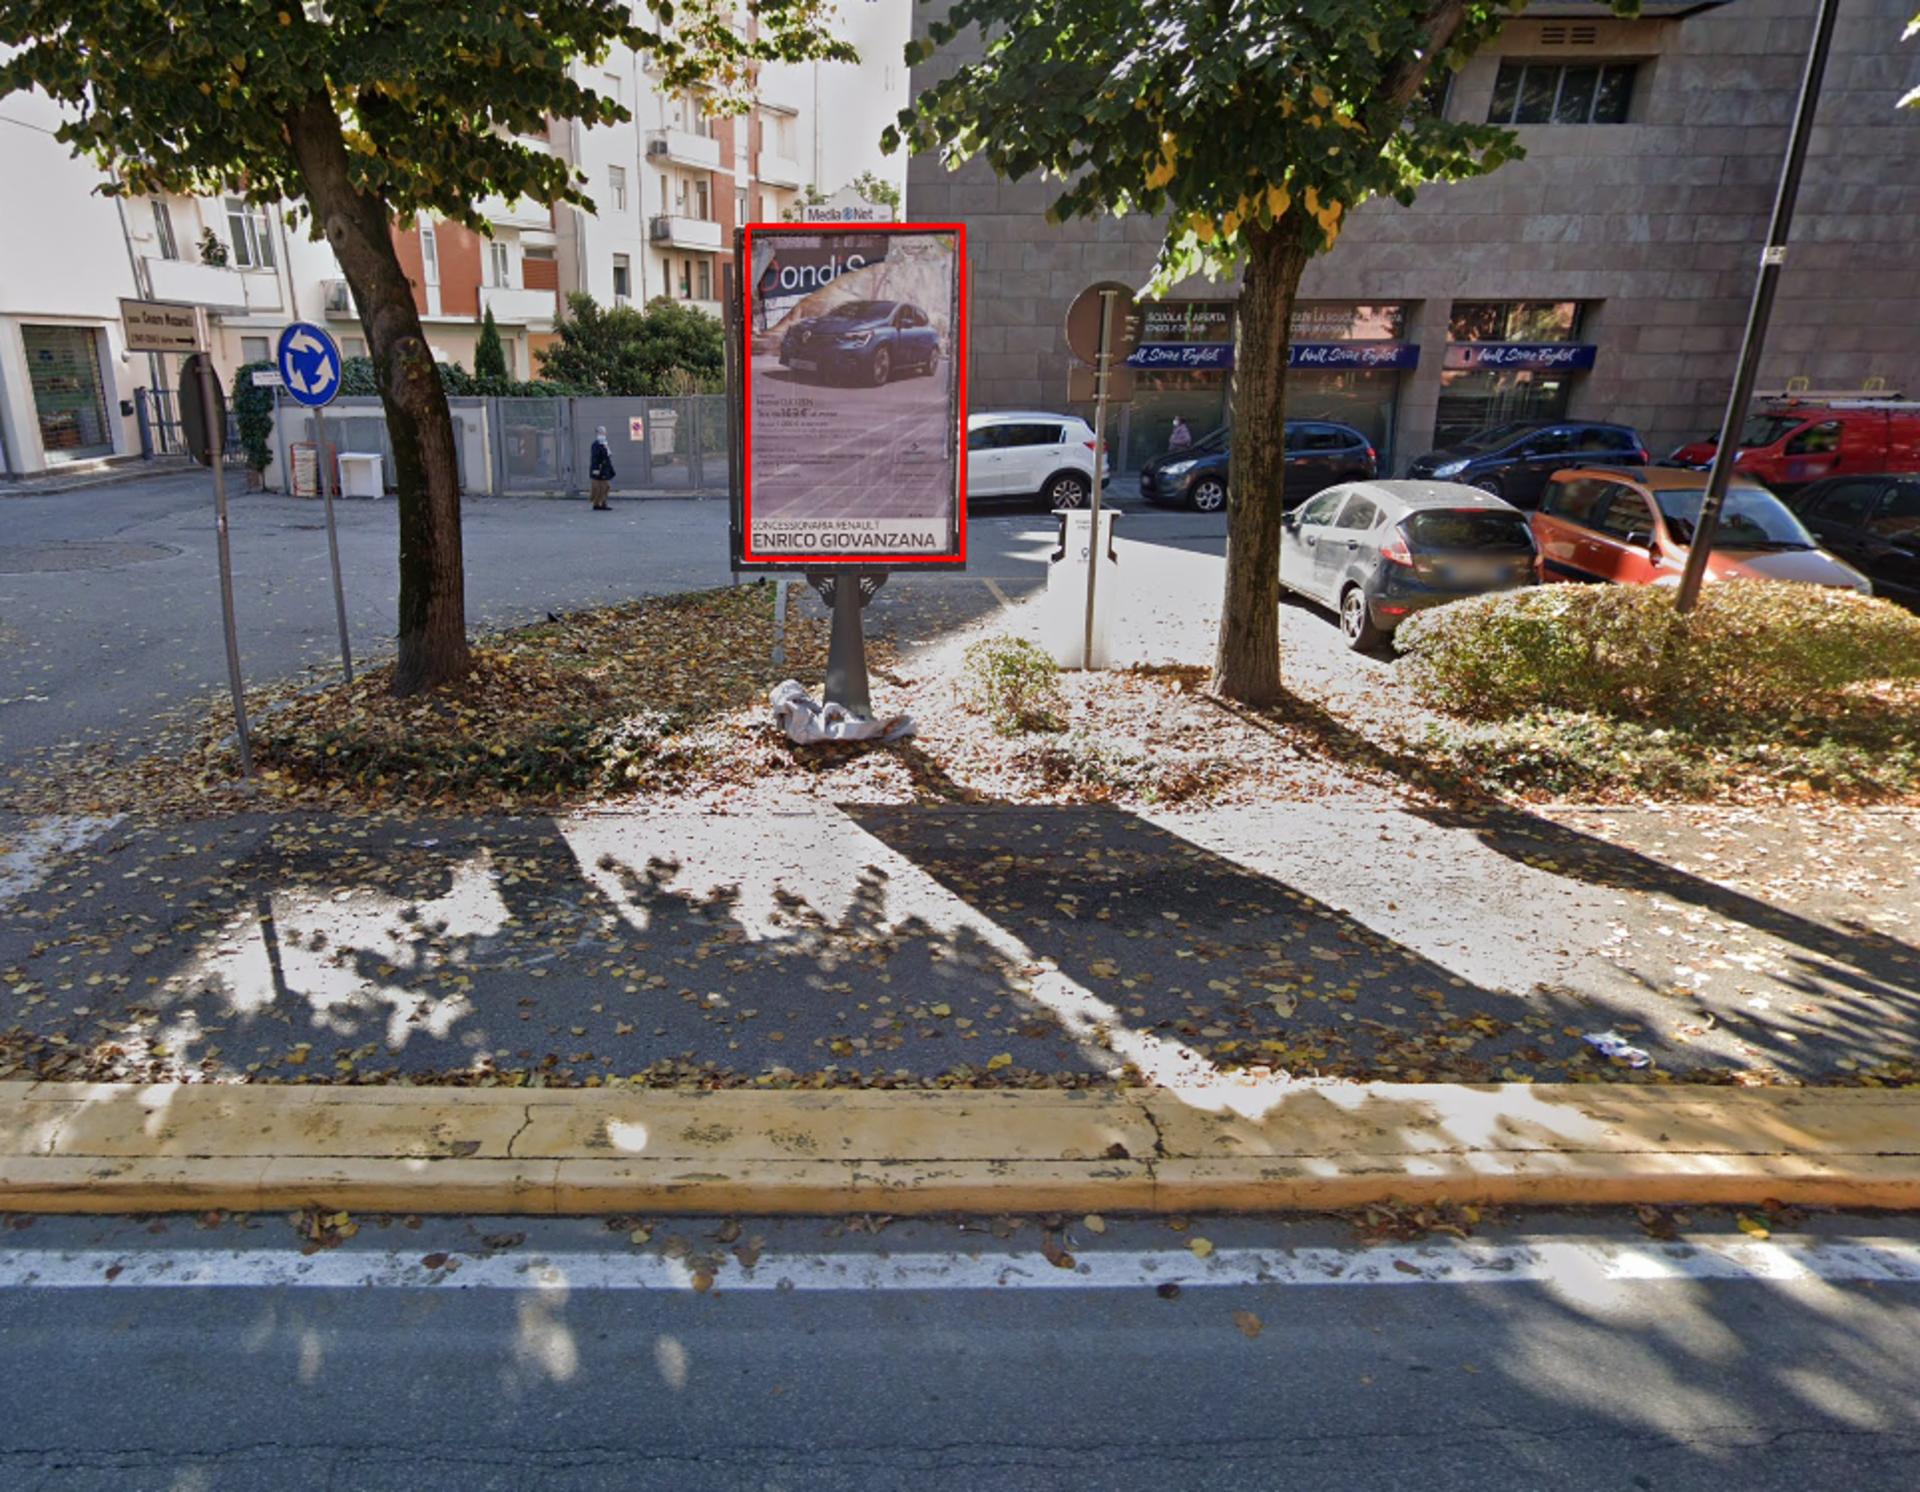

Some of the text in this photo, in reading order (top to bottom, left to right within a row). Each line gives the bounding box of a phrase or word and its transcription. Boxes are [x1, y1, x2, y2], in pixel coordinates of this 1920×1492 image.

[808, 208, 873, 221] Media Net
[1182, 348, 1220, 365] English
[1362, 348, 1400, 365] English
[1539, 348, 1577, 366] English
[752, 521, 880, 531] CONCESSIONARIA RENAULT
[753, 533, 937, 548] ENRICO GIOVANZANA
